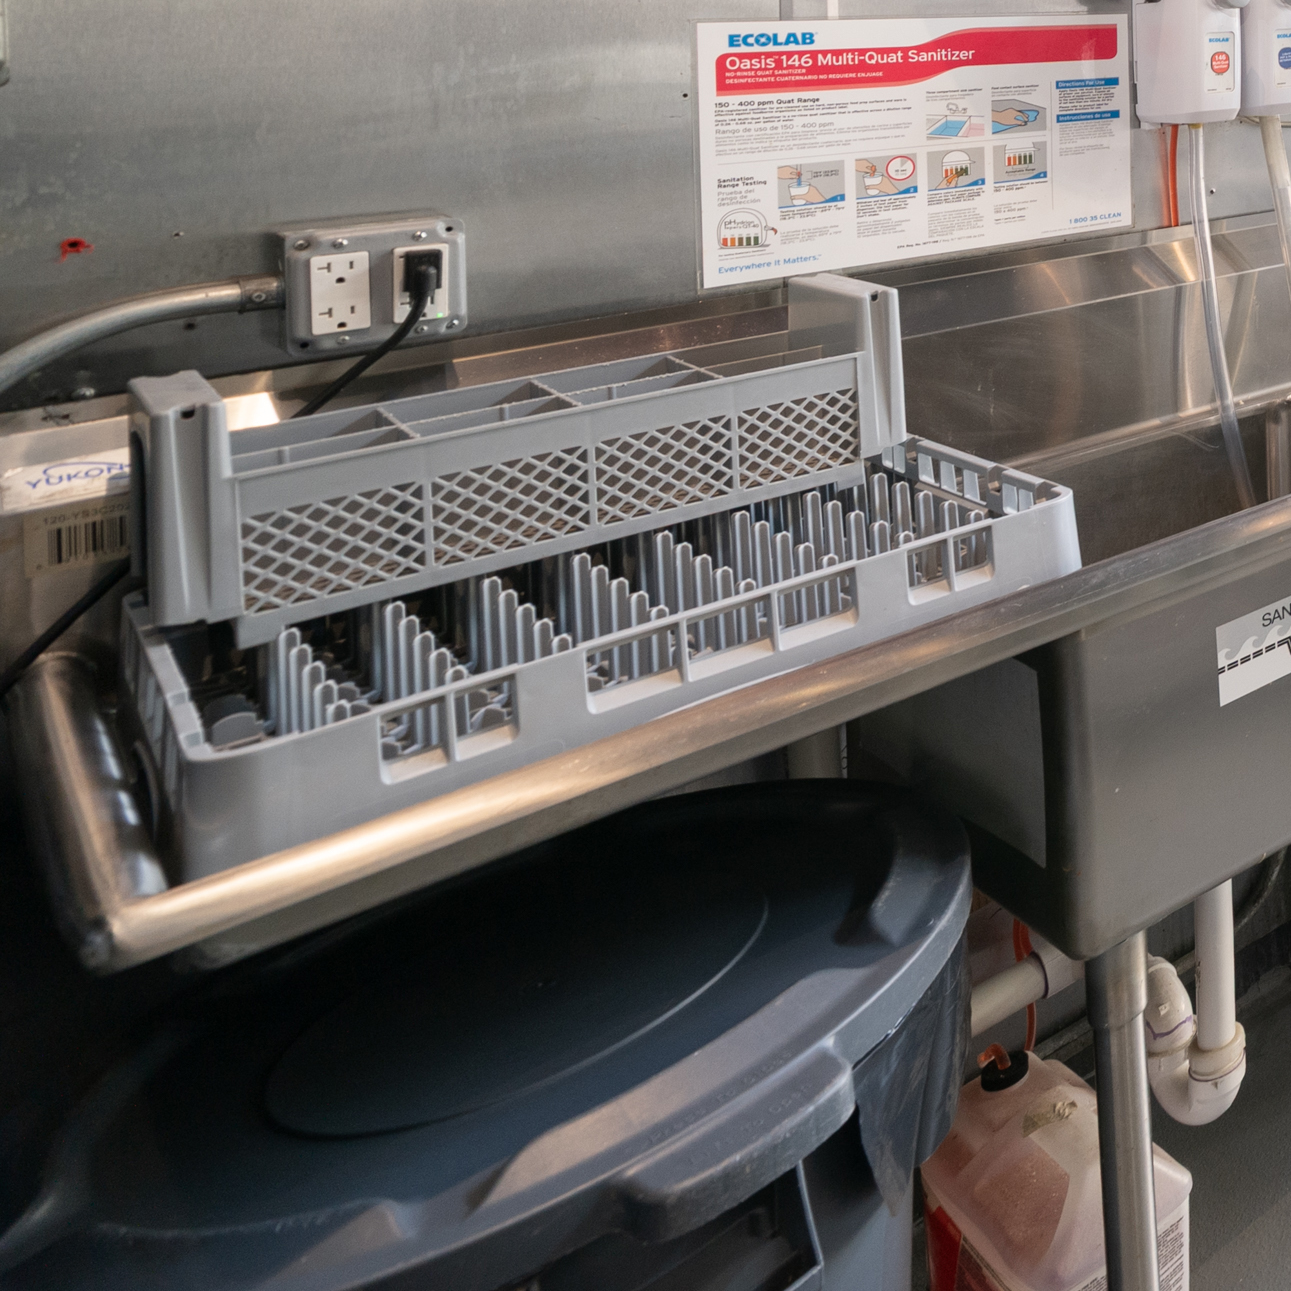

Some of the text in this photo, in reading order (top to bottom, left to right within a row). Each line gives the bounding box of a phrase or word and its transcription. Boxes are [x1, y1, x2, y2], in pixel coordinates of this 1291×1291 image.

[728, 32, 815, 48] ECOLAB
[780, 54, 813, 68] 146
[817, 50, 904, 67] Multi-Quat
[907, 48, 976, 63] Sanitizer
[725, 76, 776, 84] DESINFECTANTE
[757, 100, 775, 108] ppm
[797, 97, 820, 105] Range
[1058, 113, 1094, 122] Instrucciones
[715, 128, 741, 136] Rango
[818, 121, 835, 129] ppm
[717, 189, 743, 197] Prueba
[1073, 216, 1088, 224] 800
[1099, 212, 1122, 220] CLEAN
[718, 260, 772, 274] Everywhere
